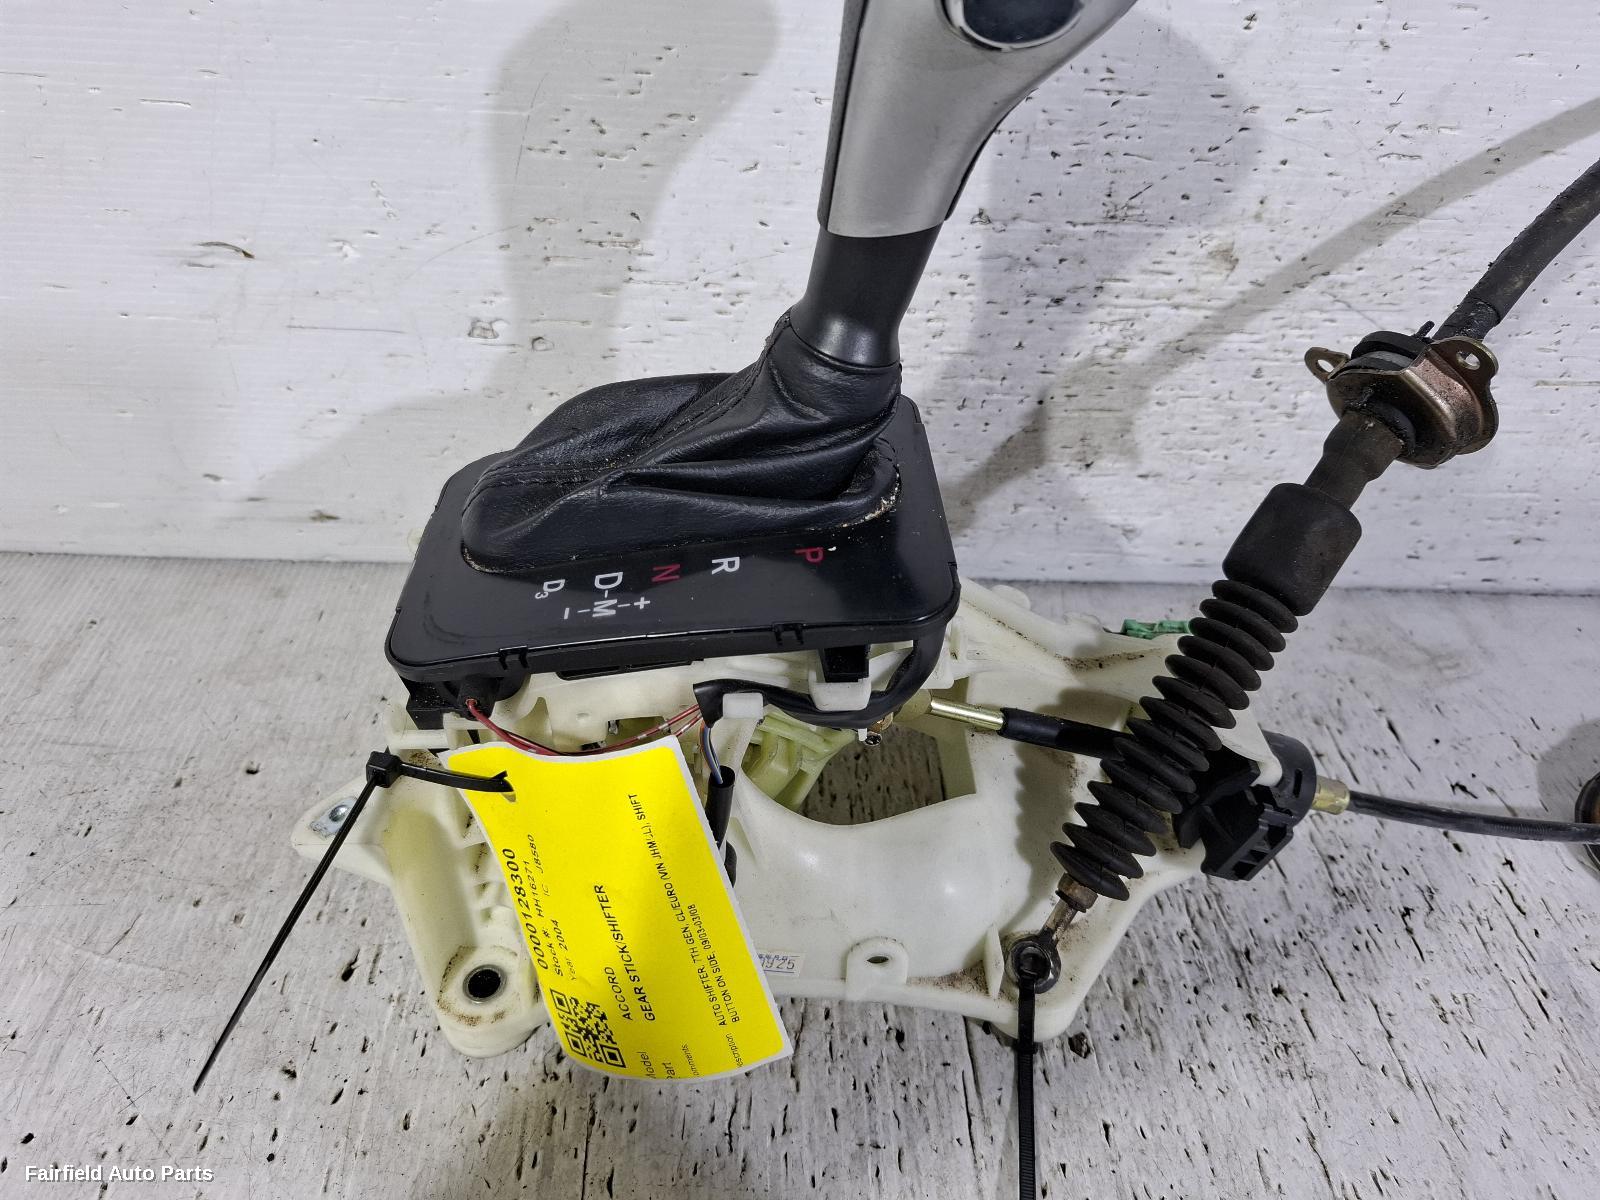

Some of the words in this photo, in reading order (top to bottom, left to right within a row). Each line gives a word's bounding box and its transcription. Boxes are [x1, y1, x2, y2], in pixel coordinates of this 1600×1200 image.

[711, 556, 740, 574] R
[795, 547, 823, 564] P
[651, 563, 681, 582] N
[628, 793, 646, 821] SHIFT
[502, 848, 548, 970] 0000128300
[551, 919, 568, 951] 2004
[593, 884, 641, 983] STICK/SHIFTER
[547, 942, 564, 977] Stock
[604, 967, 633, 1020] ACCORD
[715, 974, 726, 988] ON
[633, 986, 656, 1021] GEAR
[712, 1003, 728, 1026] AUTO
[721, 989, 740, 1023] BUTTON
[726, 1032, 744, 1067] escription
